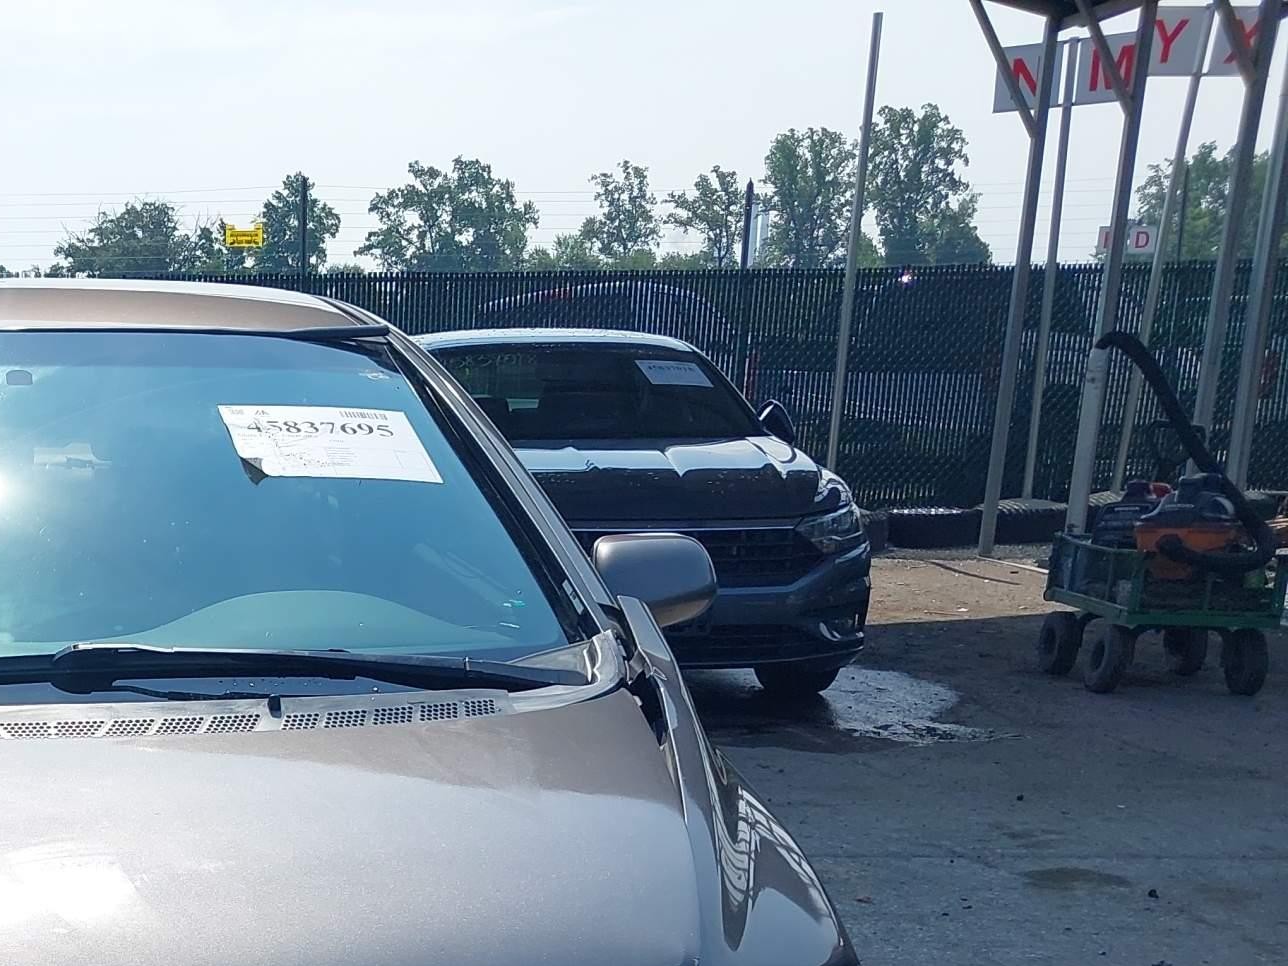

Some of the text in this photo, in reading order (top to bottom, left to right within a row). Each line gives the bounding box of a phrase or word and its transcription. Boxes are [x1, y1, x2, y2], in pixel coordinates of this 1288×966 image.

[1155, 18, 1190, 64] Y
[1089, 44, 1137, 92] M
[1134, 231, 1150, 248] D
[247, 419, 394, 437] 45837695
